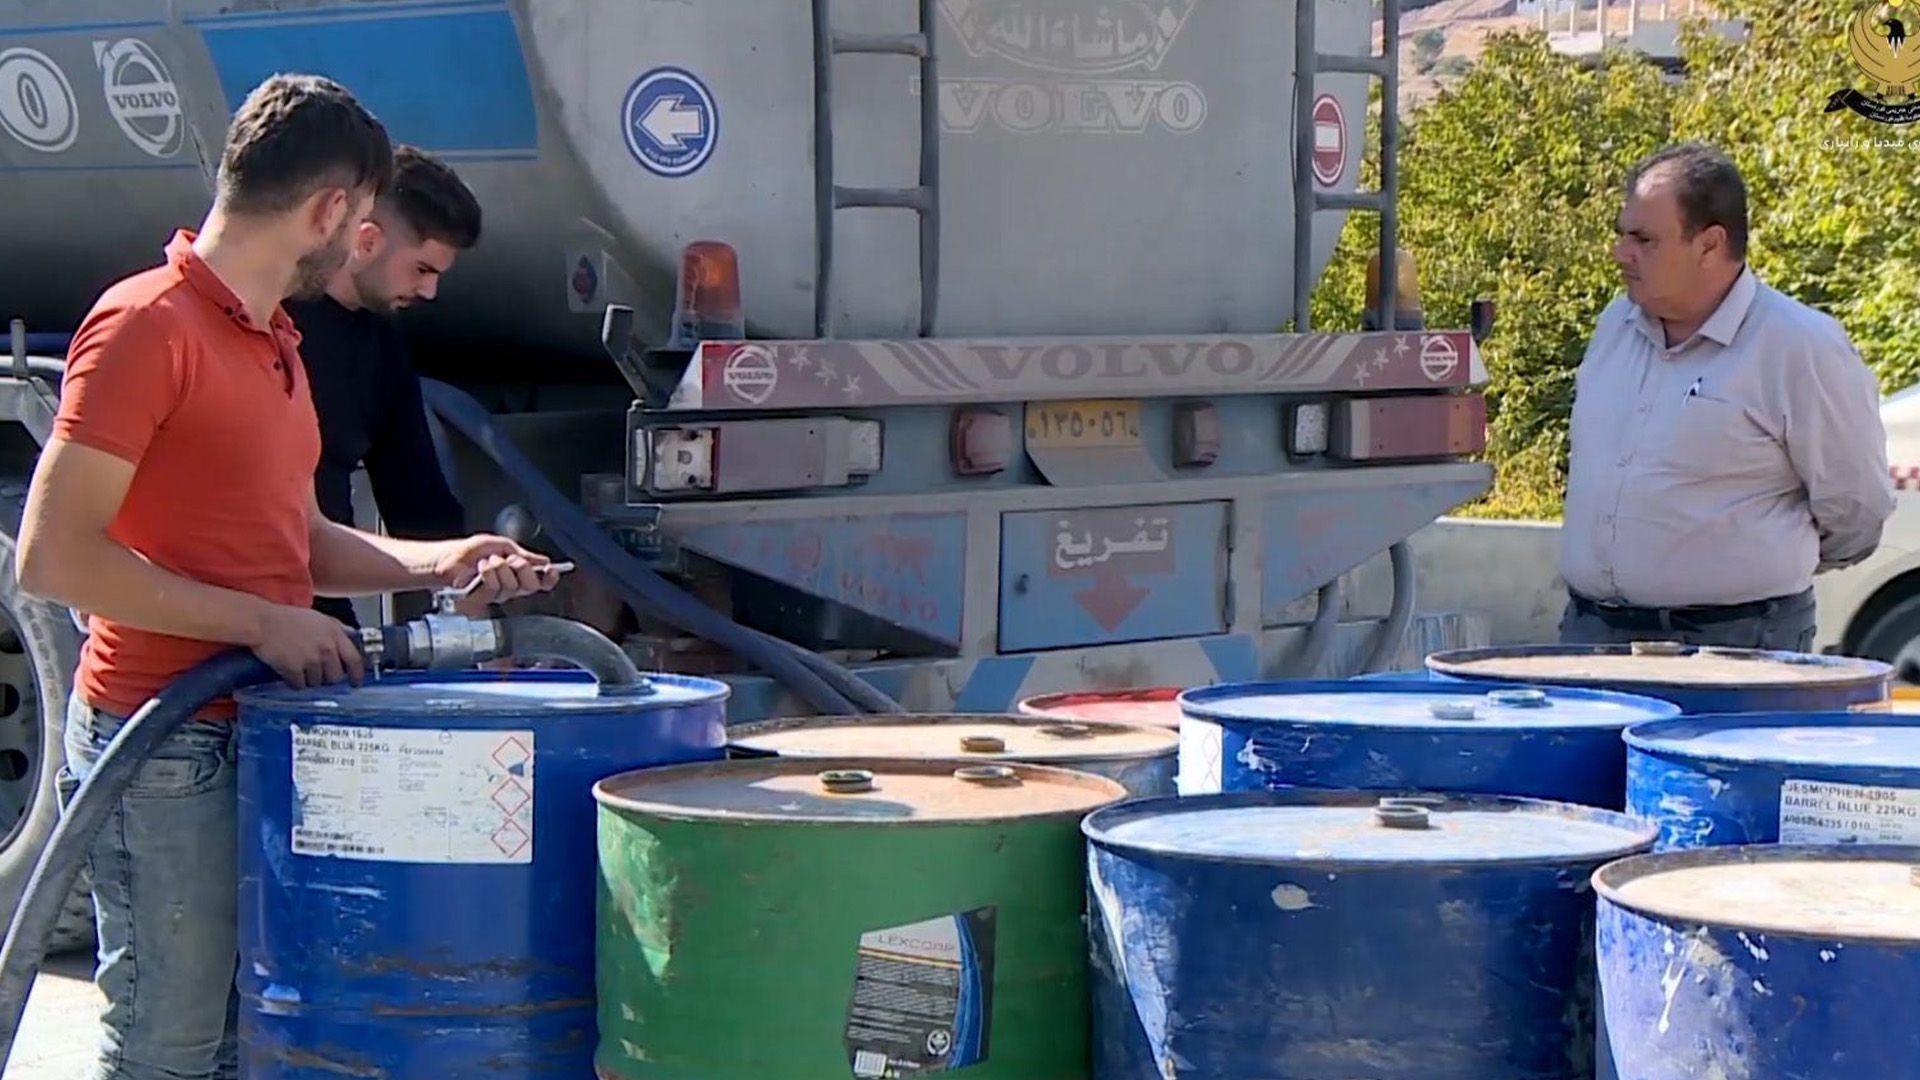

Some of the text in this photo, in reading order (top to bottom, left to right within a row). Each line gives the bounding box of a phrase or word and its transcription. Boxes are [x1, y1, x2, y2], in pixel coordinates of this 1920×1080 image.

[113, 91, 177, 110] VOLVO
[910, 76, 1207, 133] VOLVO
[967, 341, 1254, 380] VOLVO
[728, 372, 775, 381] VOLVO
[1054, 517, 1171, 570] تفريغ
[330, 741, 355, 751] BLUE
[358, 743, 390, 753] 225KG
[1785, 796, 1918, 818] BARREL BLUE 225KG
